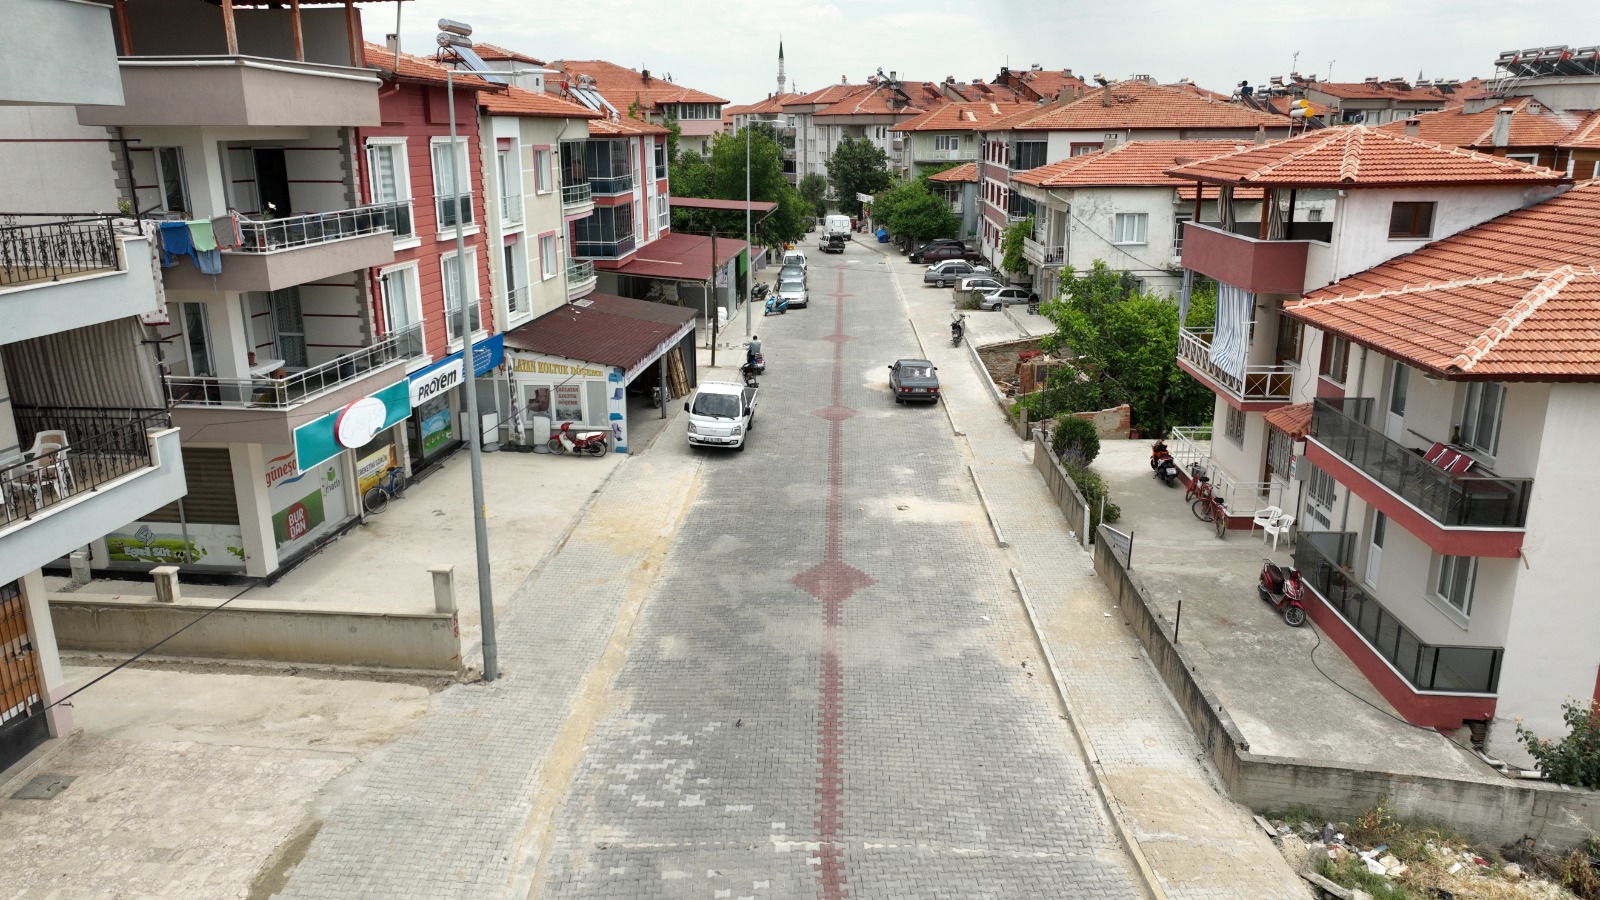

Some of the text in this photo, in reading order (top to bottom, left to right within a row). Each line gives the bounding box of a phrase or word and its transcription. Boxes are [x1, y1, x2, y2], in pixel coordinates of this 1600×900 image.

[538, 361, 569, 375] KOLTUK
[570, 364, 603, 378] DÖŞEME
[288, 507, 304, 526] BUR
[289, 519, 306, 538] DAN
